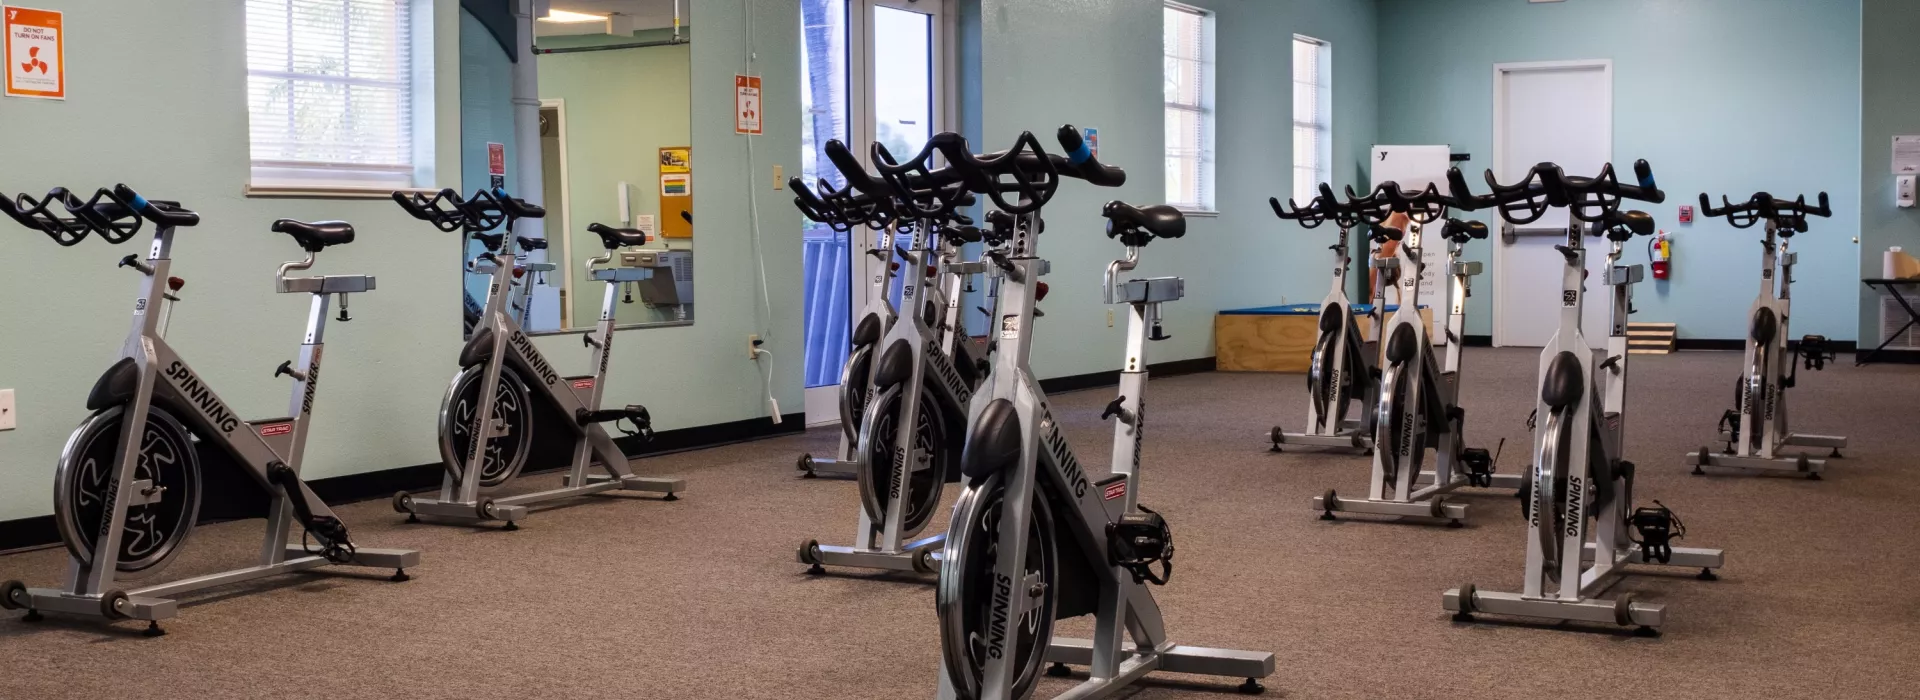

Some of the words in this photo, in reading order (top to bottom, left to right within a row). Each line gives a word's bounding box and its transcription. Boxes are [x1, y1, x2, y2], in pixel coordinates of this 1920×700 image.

[510, 330, 558, 386] SPINNING
[600, 334, 612, 374] SPINNER
[926, 340, 969, 404] SPINNING
[165, 360, 238, 433] SPINNING
[303, 362, 319, 415] SPINNER
[1329, 368, 1340, 402] SPINNING
[1743, 377, 1752, 415] SPINNING
[469, 416, 482, 461] SPINNING
[1133, 397, 1146, 469] SPINNER
[1401, 412, 1413, 457] SPINNING
[890, 445, 905, 499] SPINNING
[101, 477, 119, 537] SPINNING
[1566, 474, 1582, 537] SPINNING
[988, 572, 1011, 660] SPINNING
